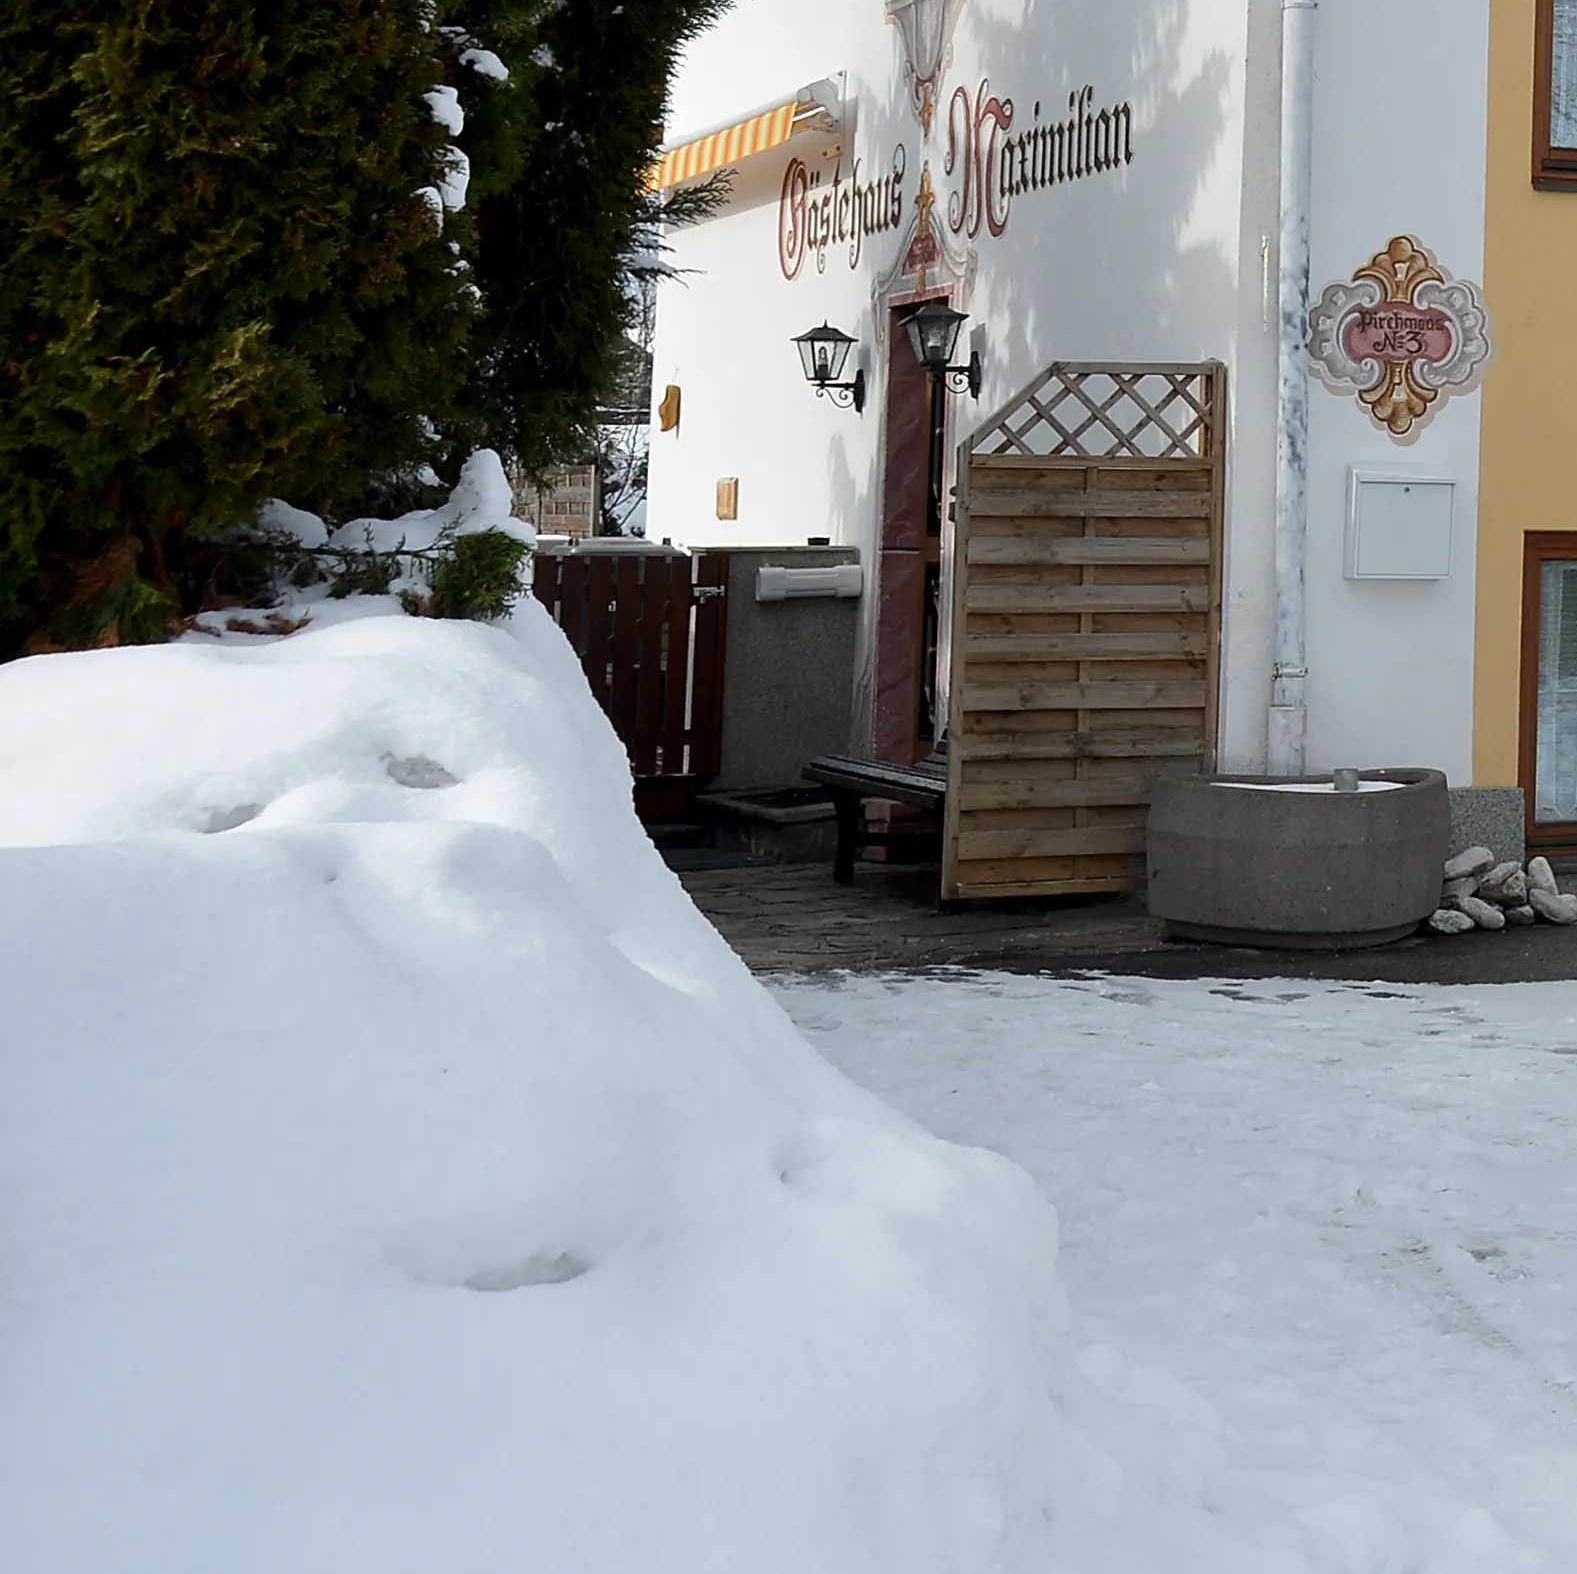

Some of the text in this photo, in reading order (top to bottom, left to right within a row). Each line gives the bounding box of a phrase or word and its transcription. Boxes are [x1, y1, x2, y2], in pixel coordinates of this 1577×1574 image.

[778, 78, 1134, 281] Gästehaus Maximilian
[1356, 310, 1445, 334] Pirchmoos
